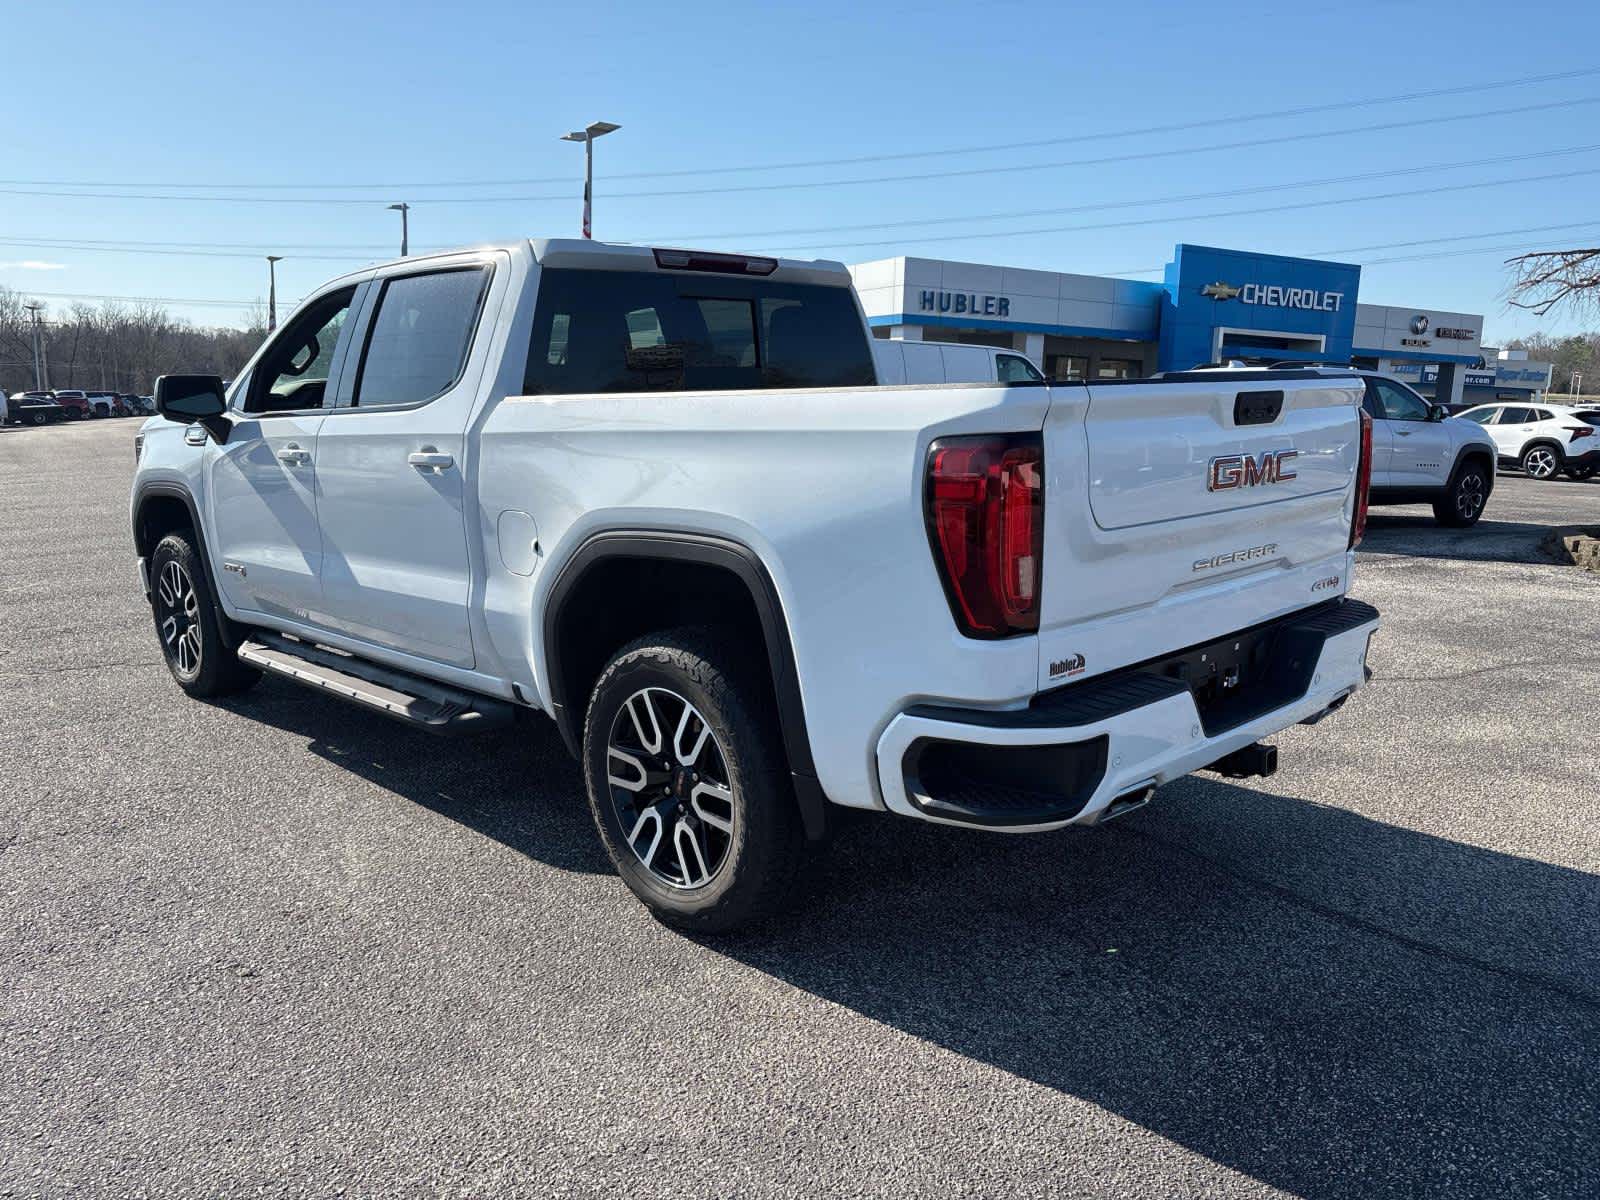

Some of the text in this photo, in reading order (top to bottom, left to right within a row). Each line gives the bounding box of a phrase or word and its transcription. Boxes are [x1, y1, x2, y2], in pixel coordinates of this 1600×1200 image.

[920, 290, 1010, 317] HUBLER
[1242, 283, 1344, 312] CHEVROLET
[1207, 449, 1298, 492] GMC
[1192, 543, 1279, 572] SIERRA
